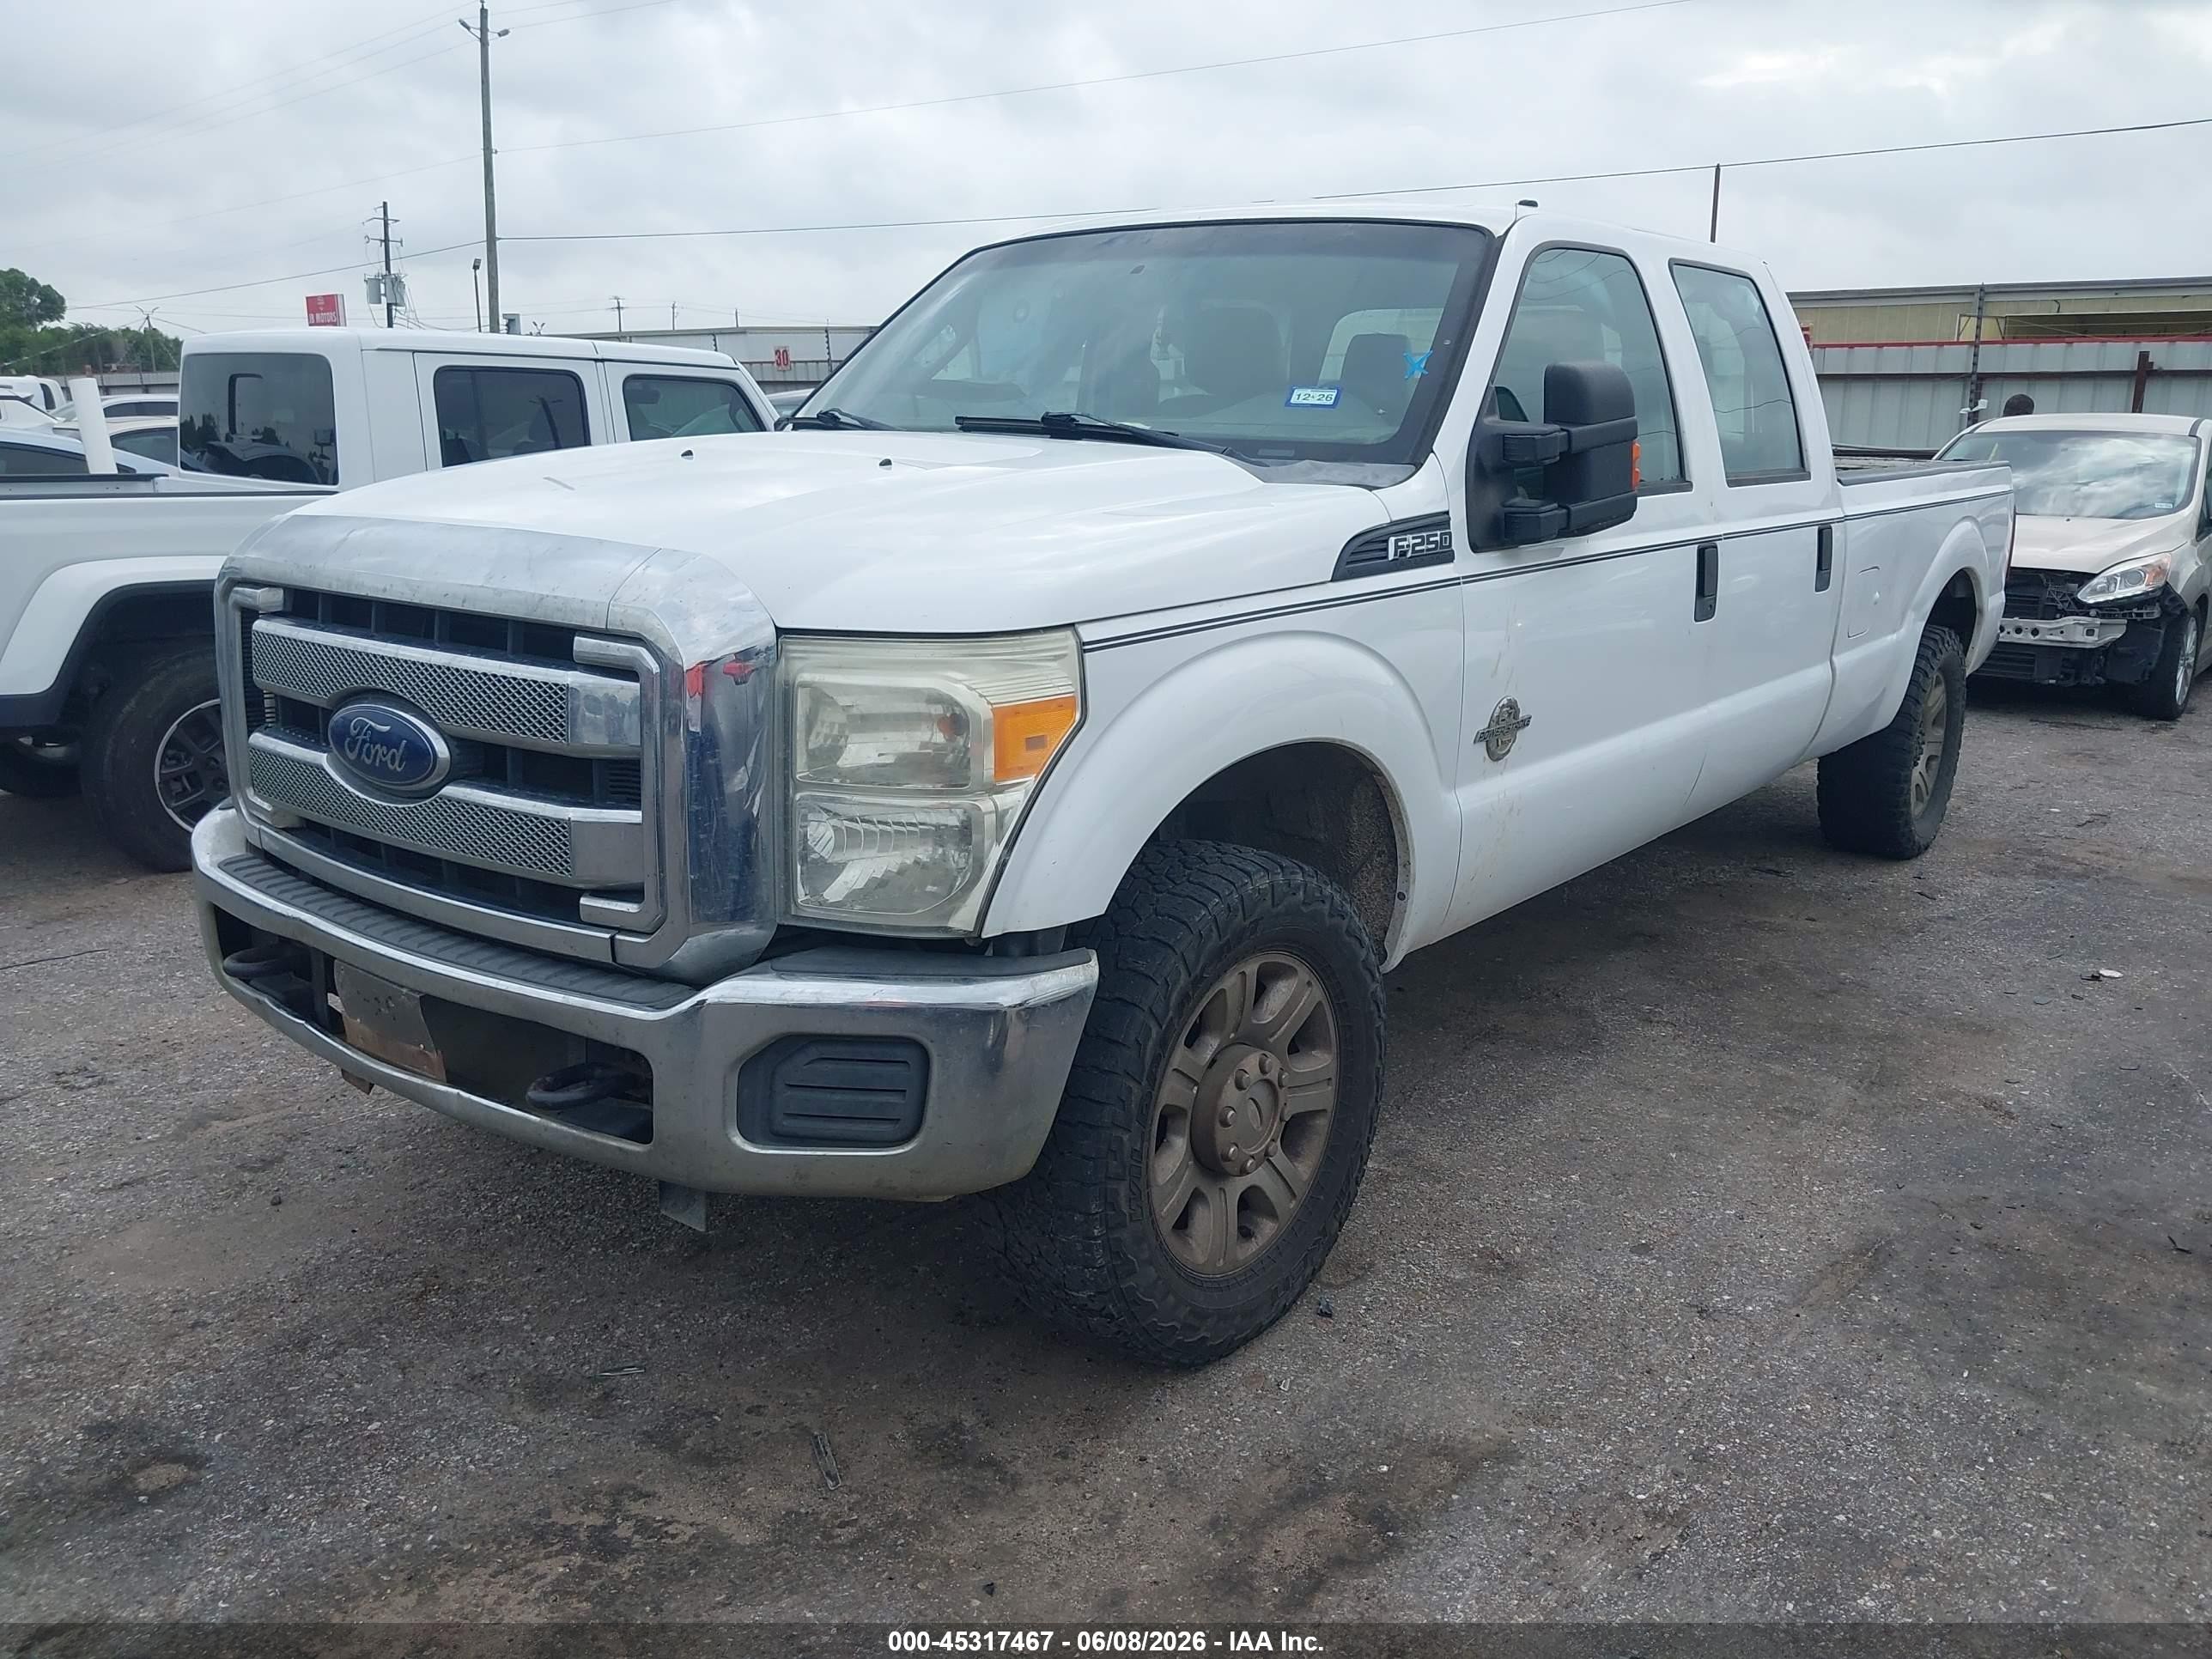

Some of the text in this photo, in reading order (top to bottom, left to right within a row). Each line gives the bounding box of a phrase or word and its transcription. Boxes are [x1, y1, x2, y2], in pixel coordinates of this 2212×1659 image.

[775, 349, 789, 366] 30
[1388, 529, 1453, 562] F-250
[344, 716, 408, 772] Ford
